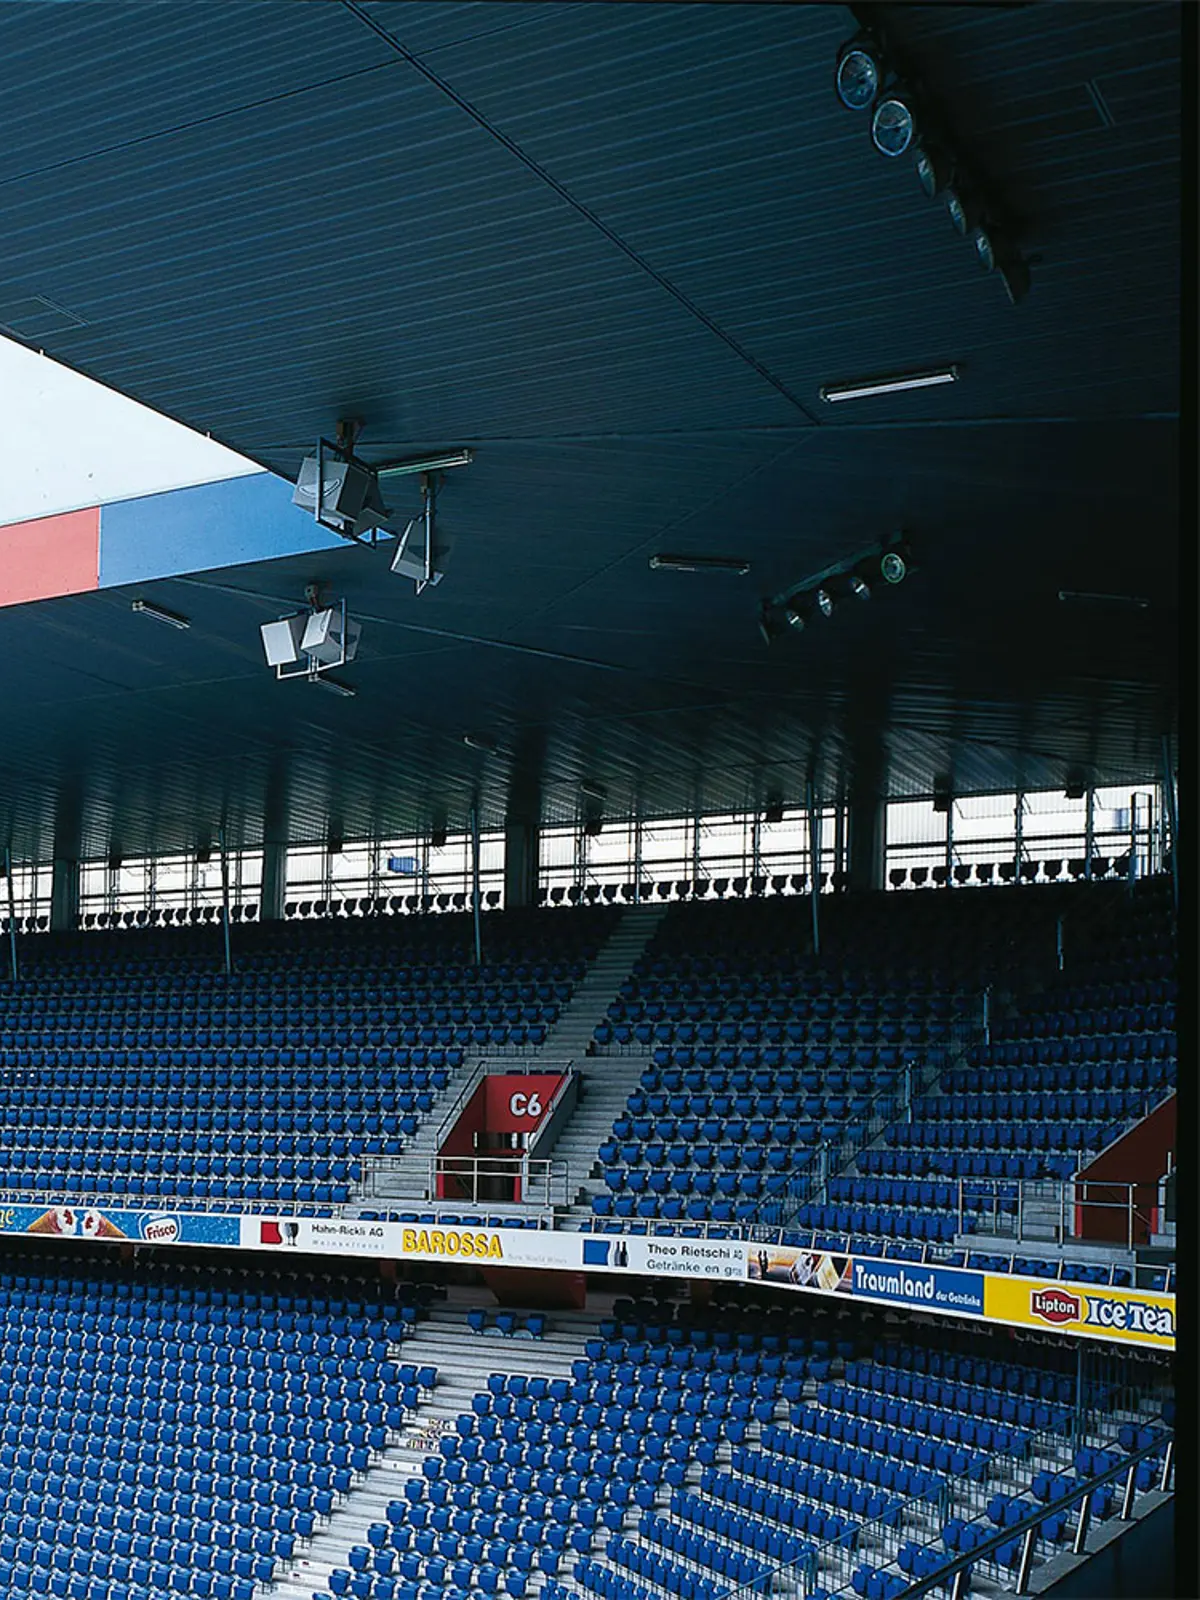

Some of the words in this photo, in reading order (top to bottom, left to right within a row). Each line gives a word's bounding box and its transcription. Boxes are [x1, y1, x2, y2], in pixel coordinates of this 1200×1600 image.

[510, 1093, 542, 1117] C6
[146, 1223, 176, 1239] Frisco
[402, 1229, 504, 1258] BAROSSA
[647, 1243, 677, 1256] Theo
[680, 1246, 730, 1259] Rietschi
[704, 1265, 720, 1274] en
[855, 1265, 935, 1299] Traumland
[1035, 1299, 1076, 1315] Lipton
